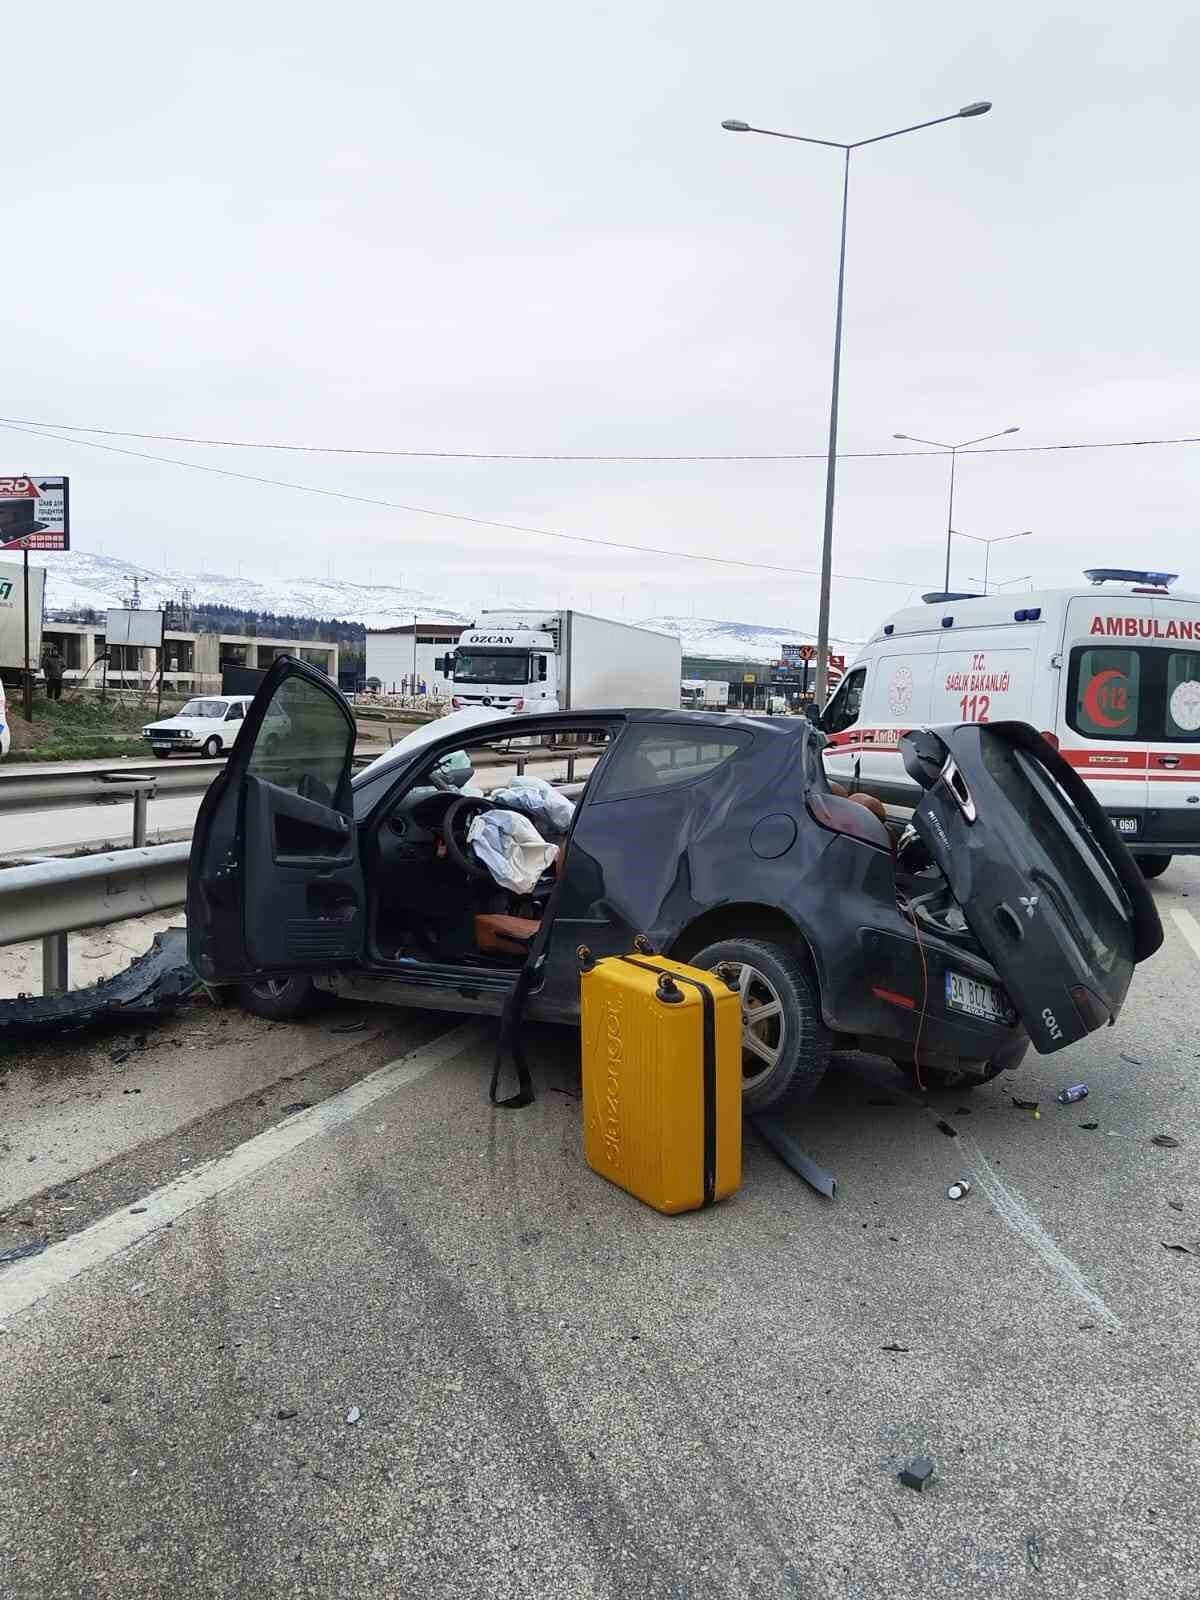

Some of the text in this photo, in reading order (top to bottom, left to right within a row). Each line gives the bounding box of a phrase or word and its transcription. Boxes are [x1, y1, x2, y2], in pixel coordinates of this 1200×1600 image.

[960, 694, 990, 722] 112
[951, 975, 964, 1004] 34
[1042, 1008, 1063, 1039] COLT
